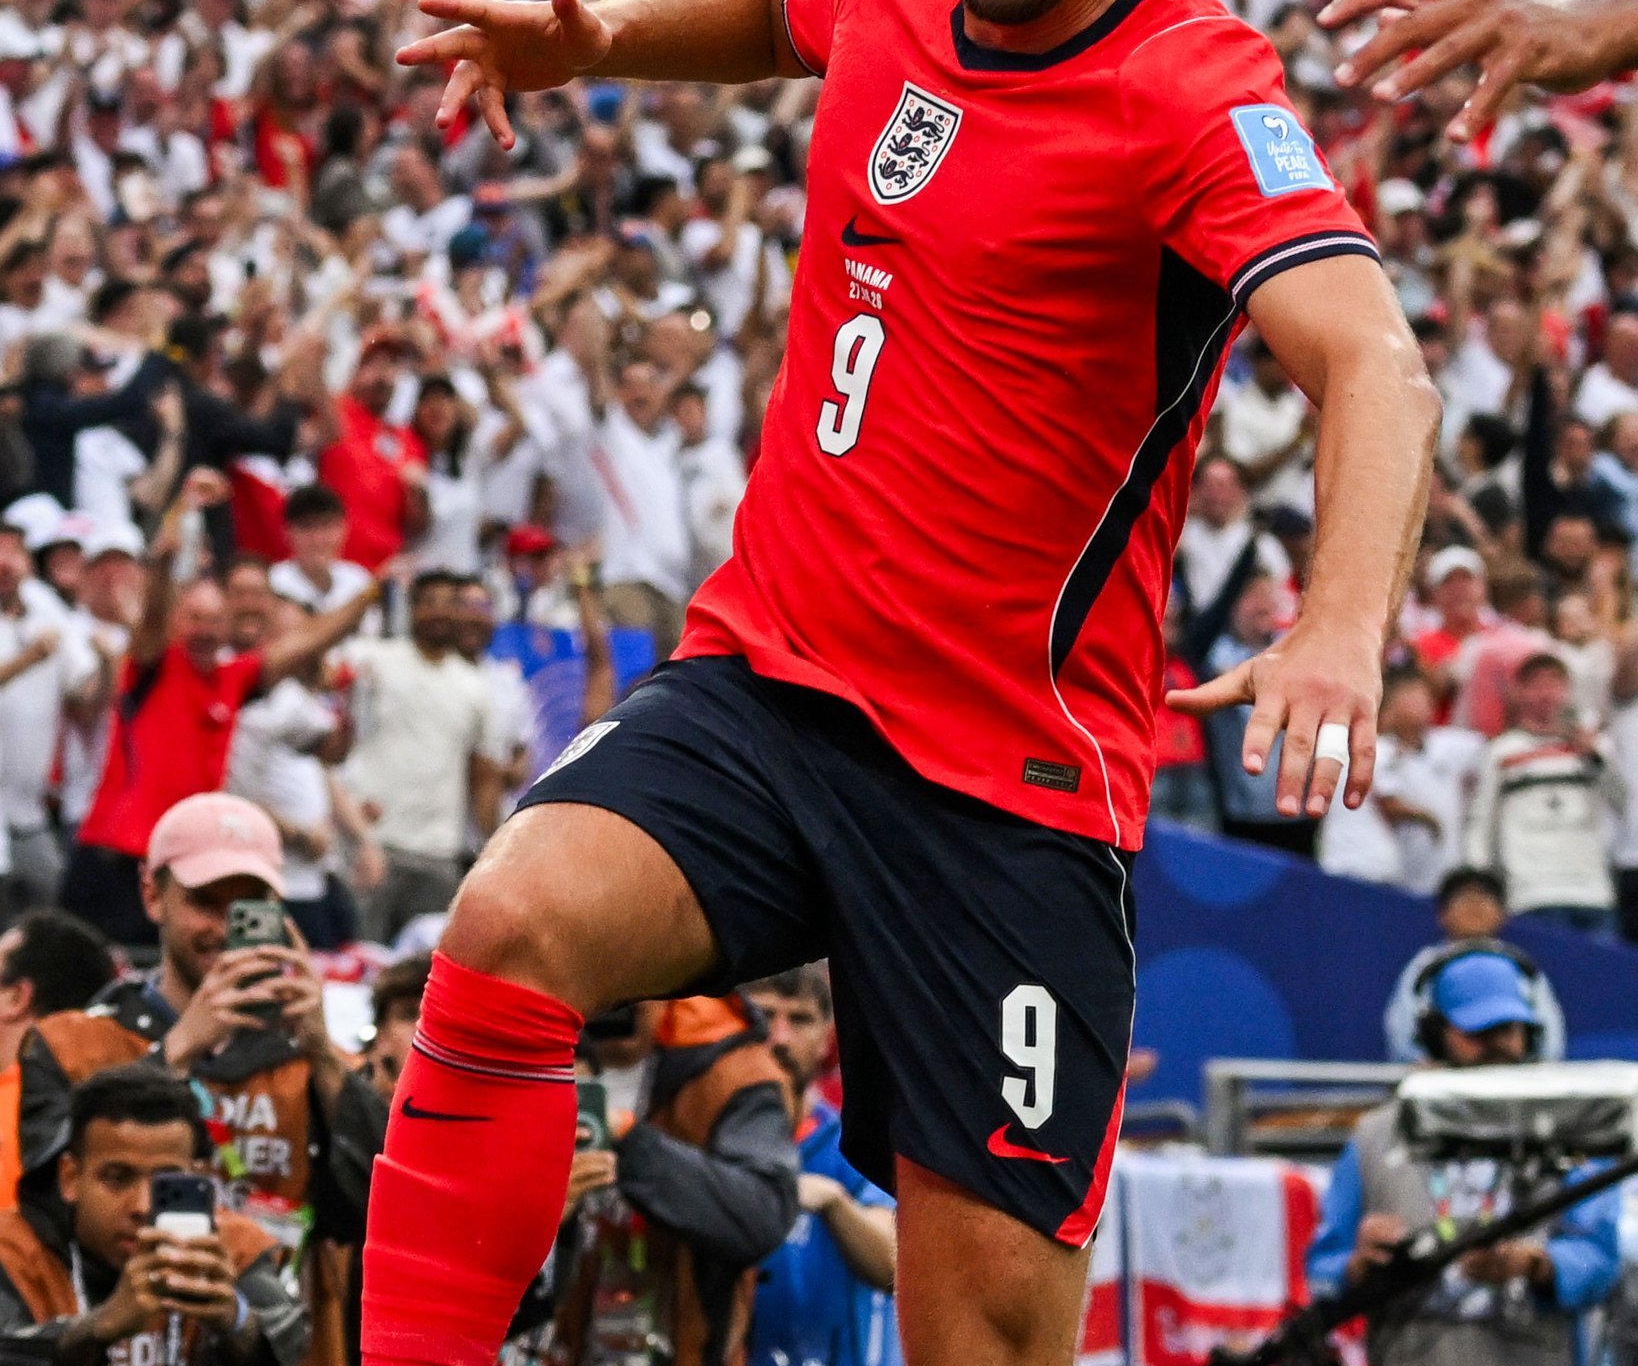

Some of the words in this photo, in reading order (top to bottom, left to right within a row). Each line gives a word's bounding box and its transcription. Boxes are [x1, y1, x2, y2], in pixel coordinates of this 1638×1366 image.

[844, 257, 894, 291] PANAMA
[815, 311, 887, 458] 9
[1001, 984, 1058, 1131] 9
